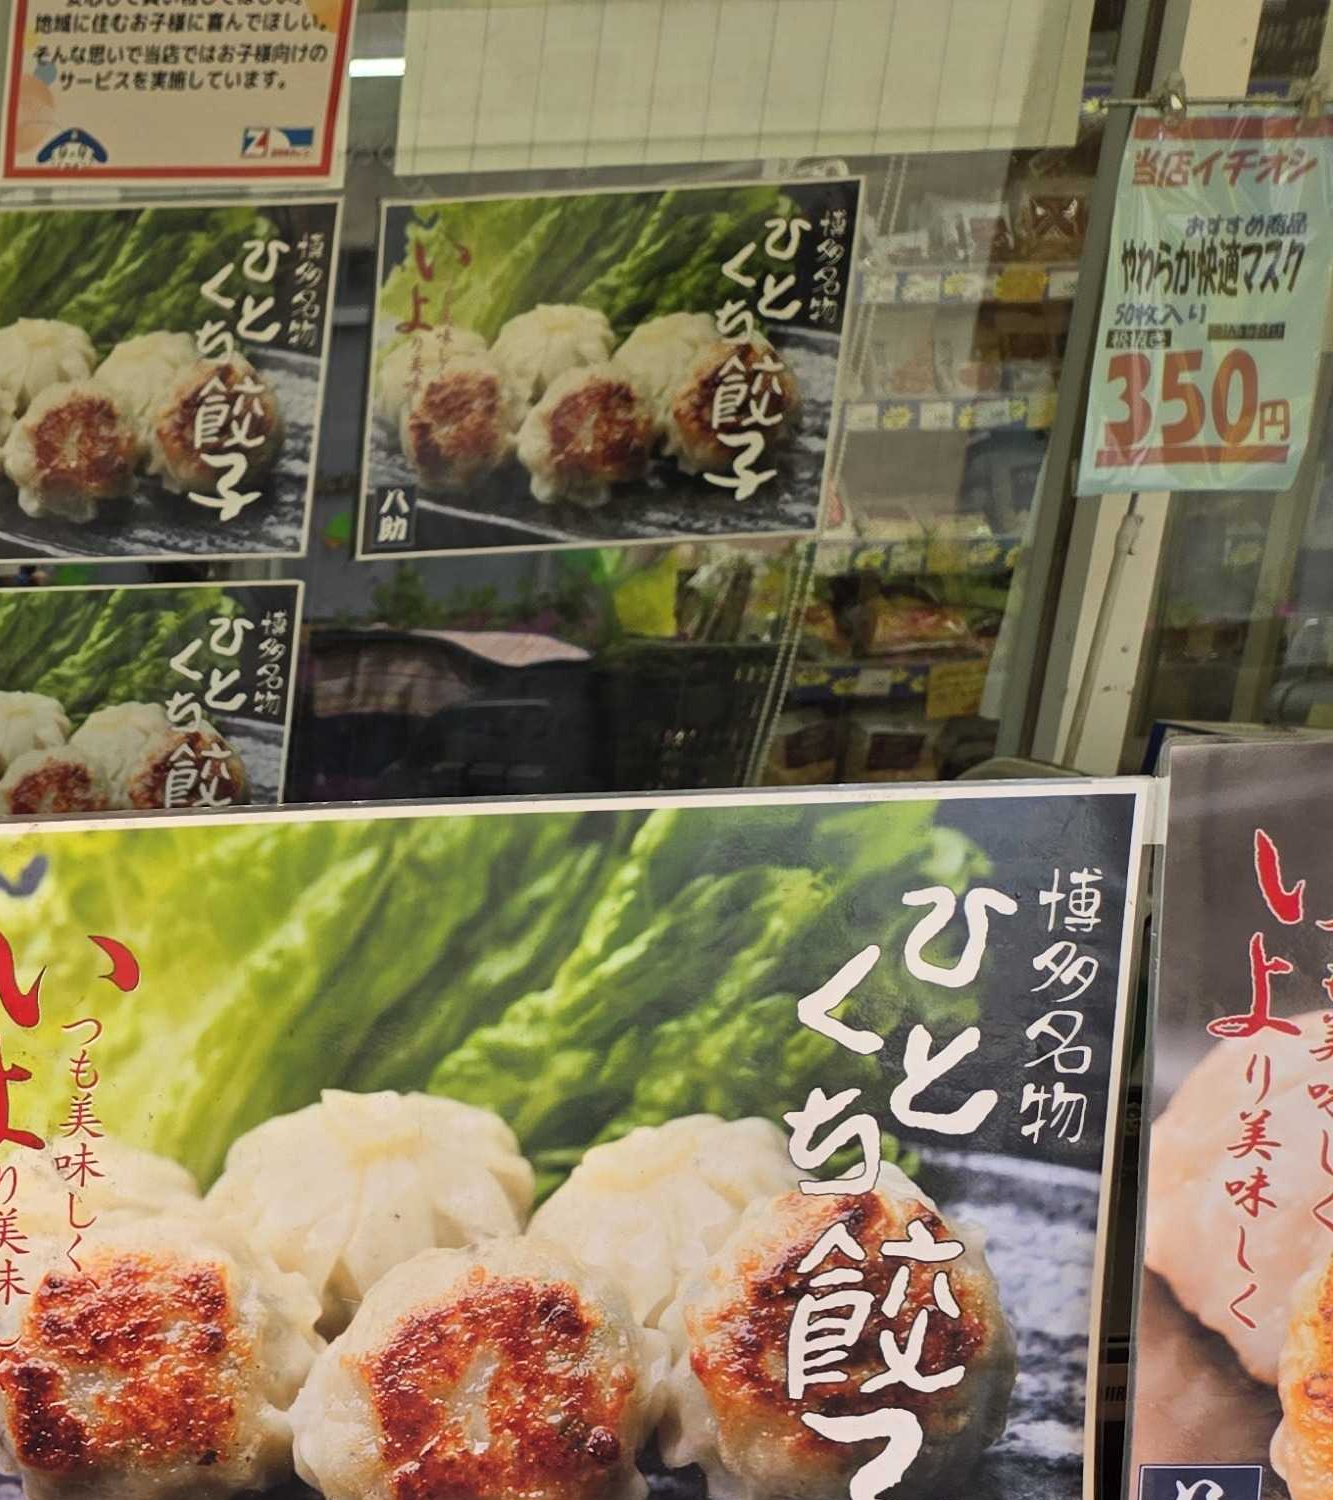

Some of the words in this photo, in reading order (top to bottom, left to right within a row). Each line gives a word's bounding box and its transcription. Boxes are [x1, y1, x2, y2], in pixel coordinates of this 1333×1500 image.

[35, 13, 329, 34] 地域に住むお子様に喜んでほしい。
[34, 43, 328, 65] そんな思いで当店ではお子様向けの
[60, 70, 287, 91] サービスを実施しています。
[1132, 148, 1317, 188] 当店イチオシ
[1186, 212, 1307, 238] おすすめ商品
[1122, 239, 1306, 296] やわらか快適マスク
[1114, 303, 1207, 325] 50枚入り
[1104, 347, 1291, 447] 350円
[378, 488, 410, 542] 八助
[1019, 866, 1105, 1146] 博多名物
